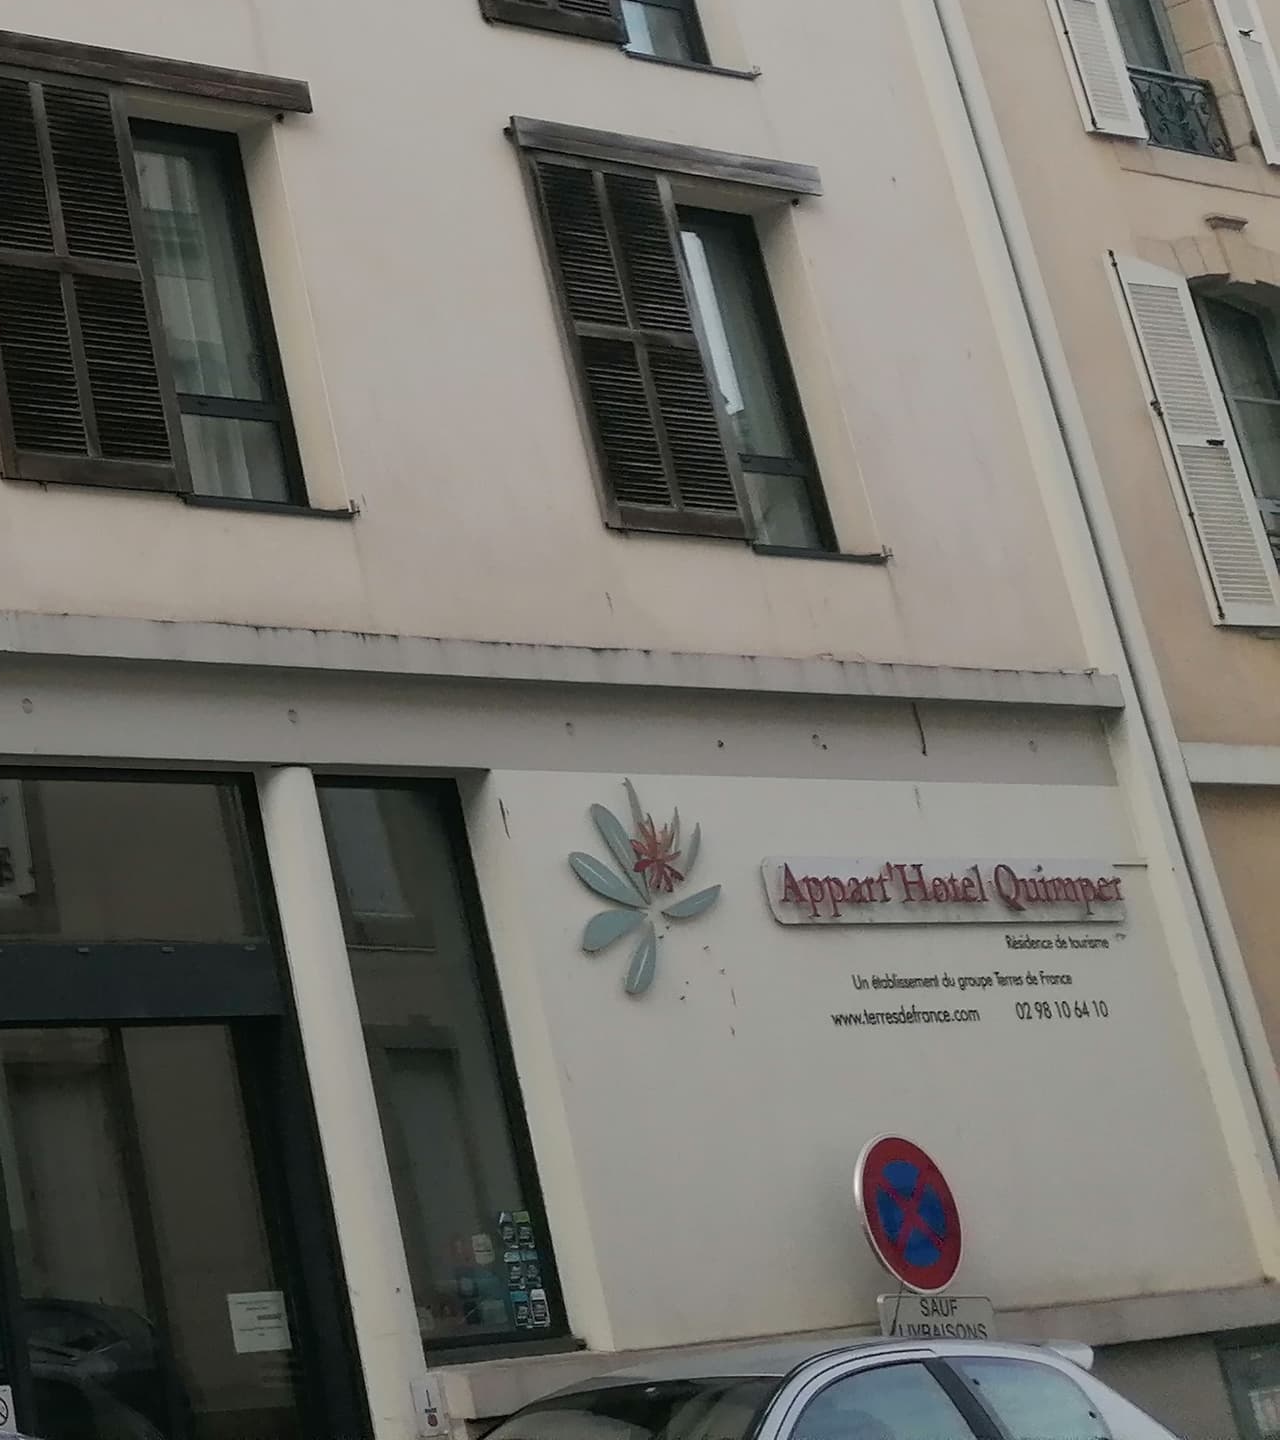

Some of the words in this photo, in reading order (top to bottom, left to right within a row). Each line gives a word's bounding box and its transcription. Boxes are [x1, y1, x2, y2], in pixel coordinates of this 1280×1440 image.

[994, 864, 1124, 915] Quimper
[1005, 934, 1053, 949] Résidence
[1055, 934, 1068, 949] de
[1068, 935, 1109, 949] tourisme
[851, 974, 869, 989] Un
[872, 973, 939, 989] établissement
[942, 972, 955, 987] du
[957, 975, 993, 991] groupe
[993, 971, 1023, 986] Terres
[1025, 971, 1038, 985] de
[1039, 971, 1072, 985] France
[831, 1004, 981, 1026] www.terresdefrance.com
[1016, 1001, 1032, 1020] 02
[1034, 1001, 1052, 1019] 98
[1054, 1000, 1071, 1018] 10
[1074, 1000, 1090, 1018] 64
[1092, 1000, 1109, 1017] 10
[920, 1298, 958, 1317] SAUF
[899, 1323, 988, 1340] LIVRAISONS
